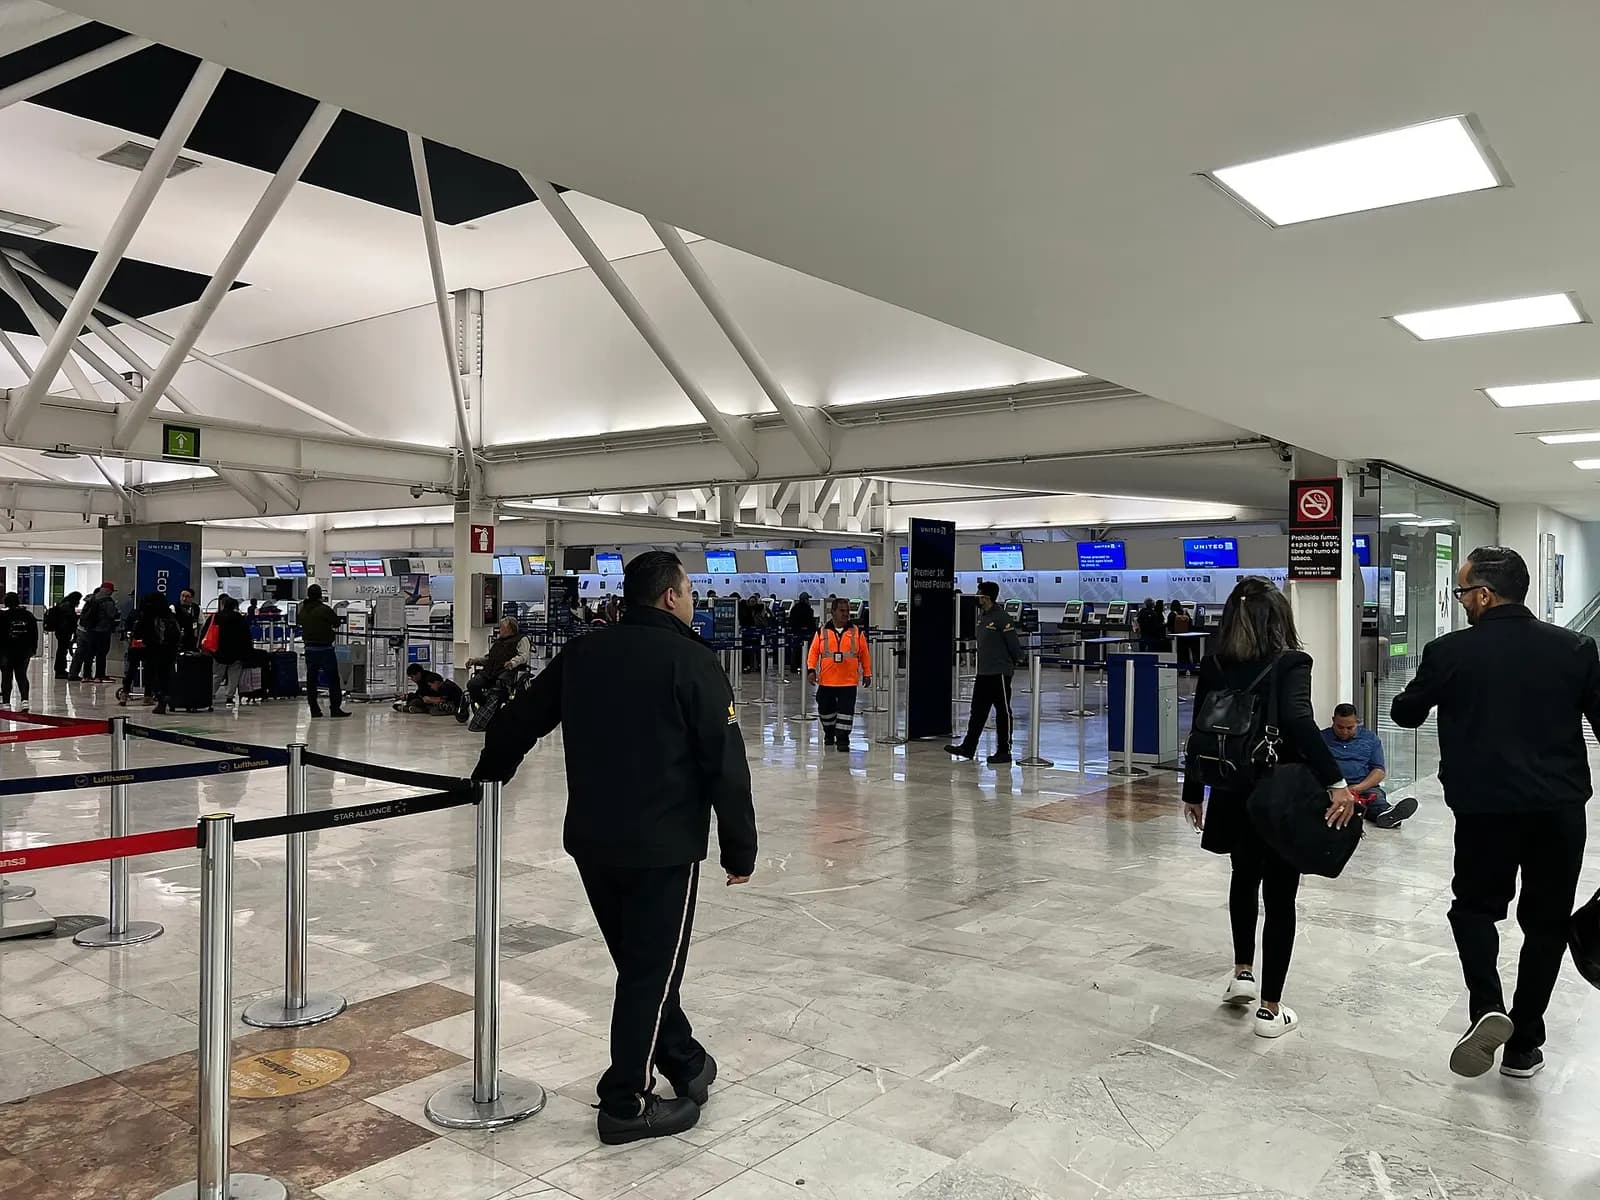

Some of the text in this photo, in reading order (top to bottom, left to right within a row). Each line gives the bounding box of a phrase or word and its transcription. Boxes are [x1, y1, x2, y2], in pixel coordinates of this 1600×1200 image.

[913, 567, 945, 577] Premier 1K
[913, 580, 932, 589] United
[233, 759, 269, 769] Lufthansa
[93, 774, 134, 784] Lufthansa
[333, 805, 392, 822] STAR ALLIANCE
